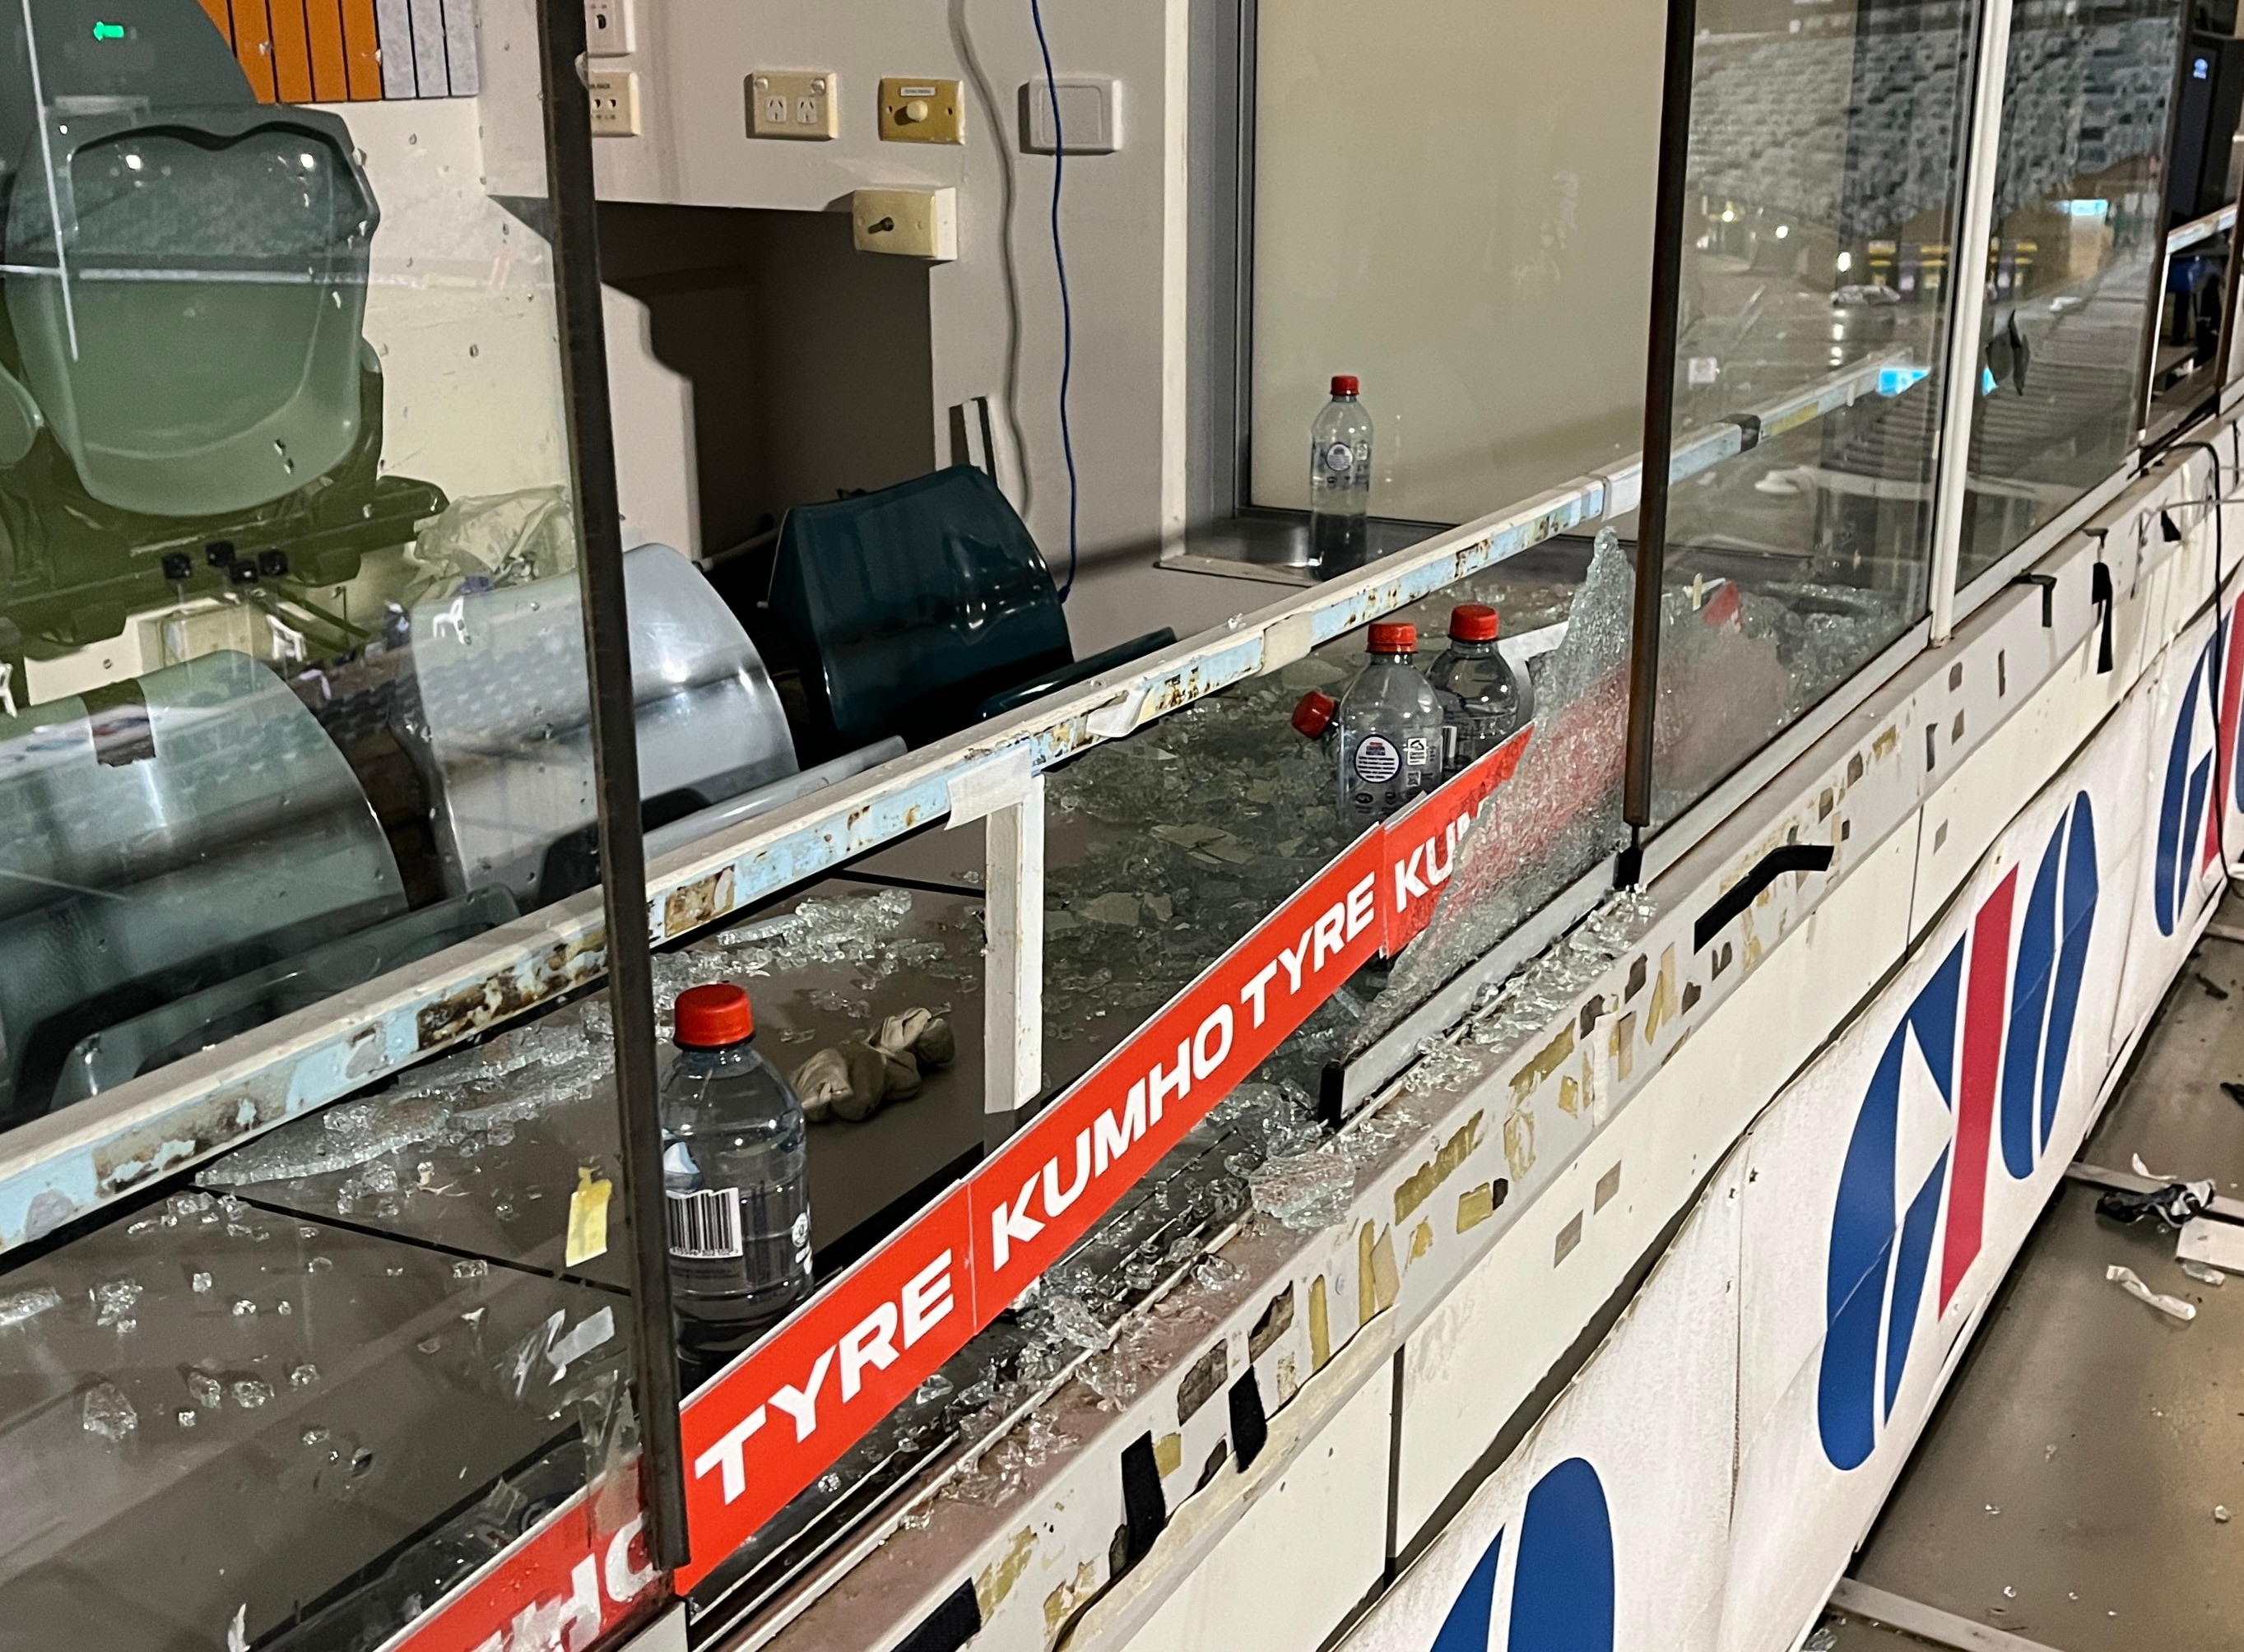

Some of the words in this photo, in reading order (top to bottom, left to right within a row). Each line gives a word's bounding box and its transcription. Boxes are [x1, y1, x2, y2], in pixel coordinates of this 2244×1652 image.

[695, 1248, 954, 1506] TYRE
[992, 1004, 1234, 1272] KUMHO
[1241, 871, 1374, 1029] TYRE
